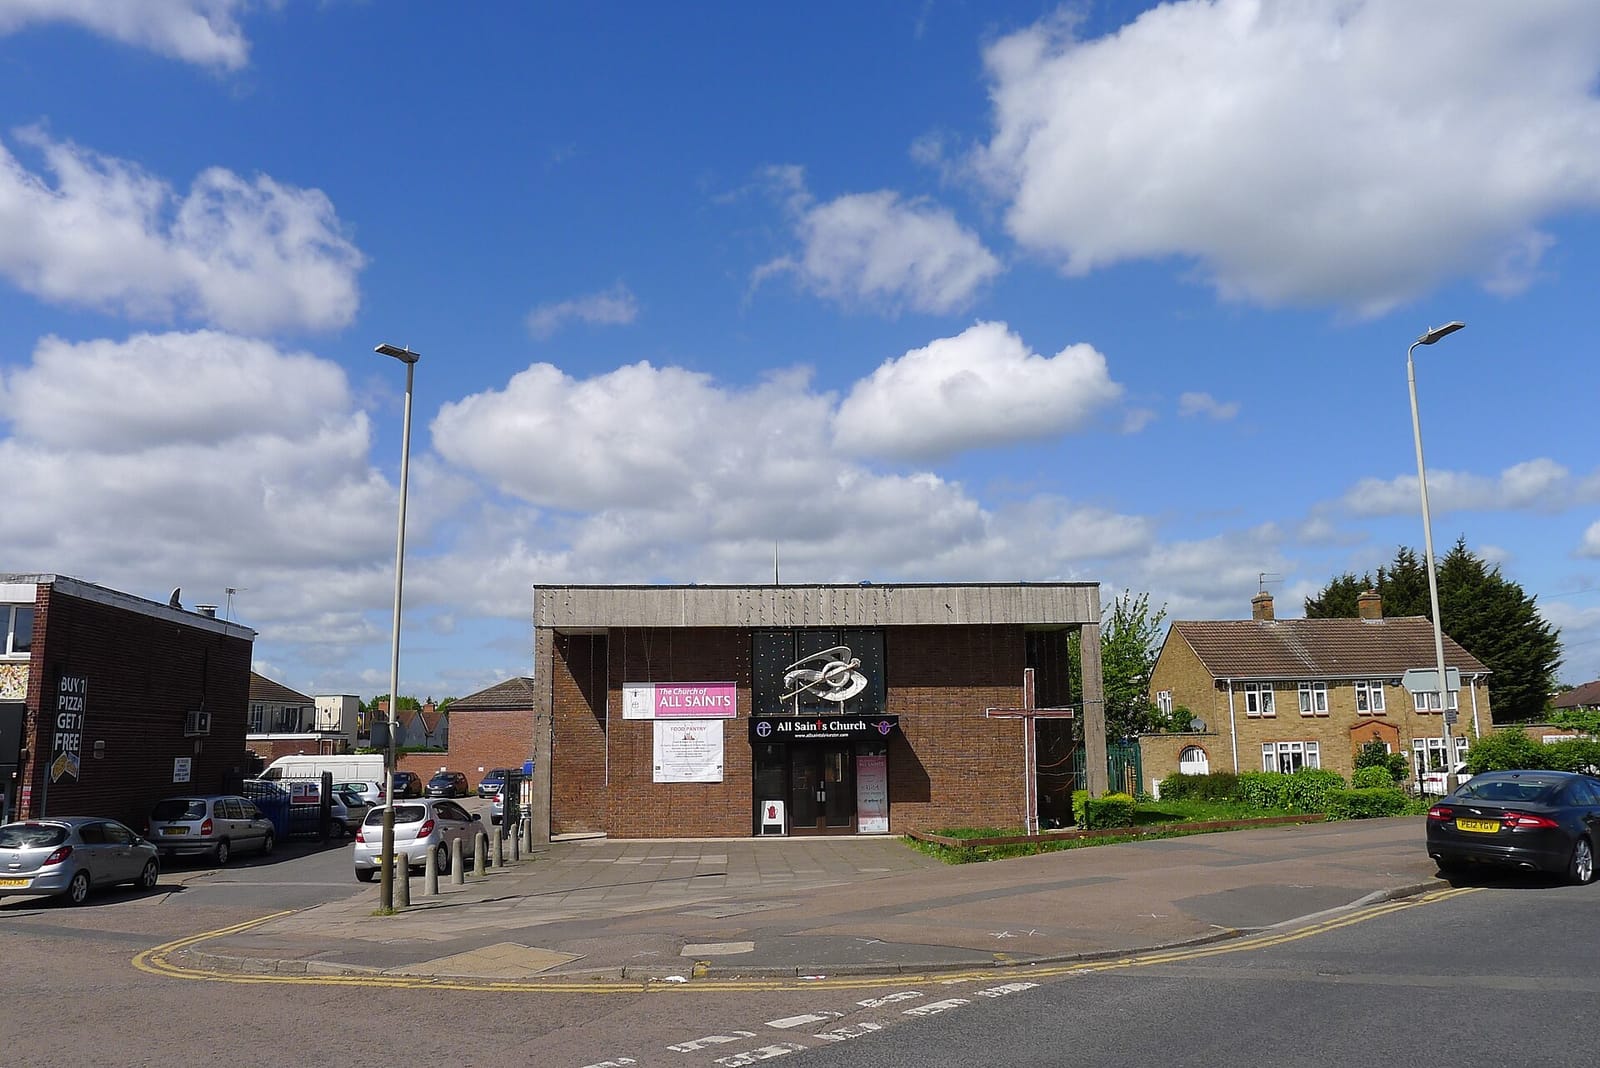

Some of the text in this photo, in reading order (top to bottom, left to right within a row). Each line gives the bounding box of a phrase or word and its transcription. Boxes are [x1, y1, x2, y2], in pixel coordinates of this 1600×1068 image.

[61, 677, 85, 693] BUY 1
[673, 687, 698, 695] Church
[699, 687, 707, 696] of
[59, 696, 82, 710] PIZZA
[660, 695, 731, 707] ALL SAINTS
[57, 713, 82, 729] GET 1
[777, 720, 866, 732] All Saints Church
[55, 733, 79, 750] FREE
